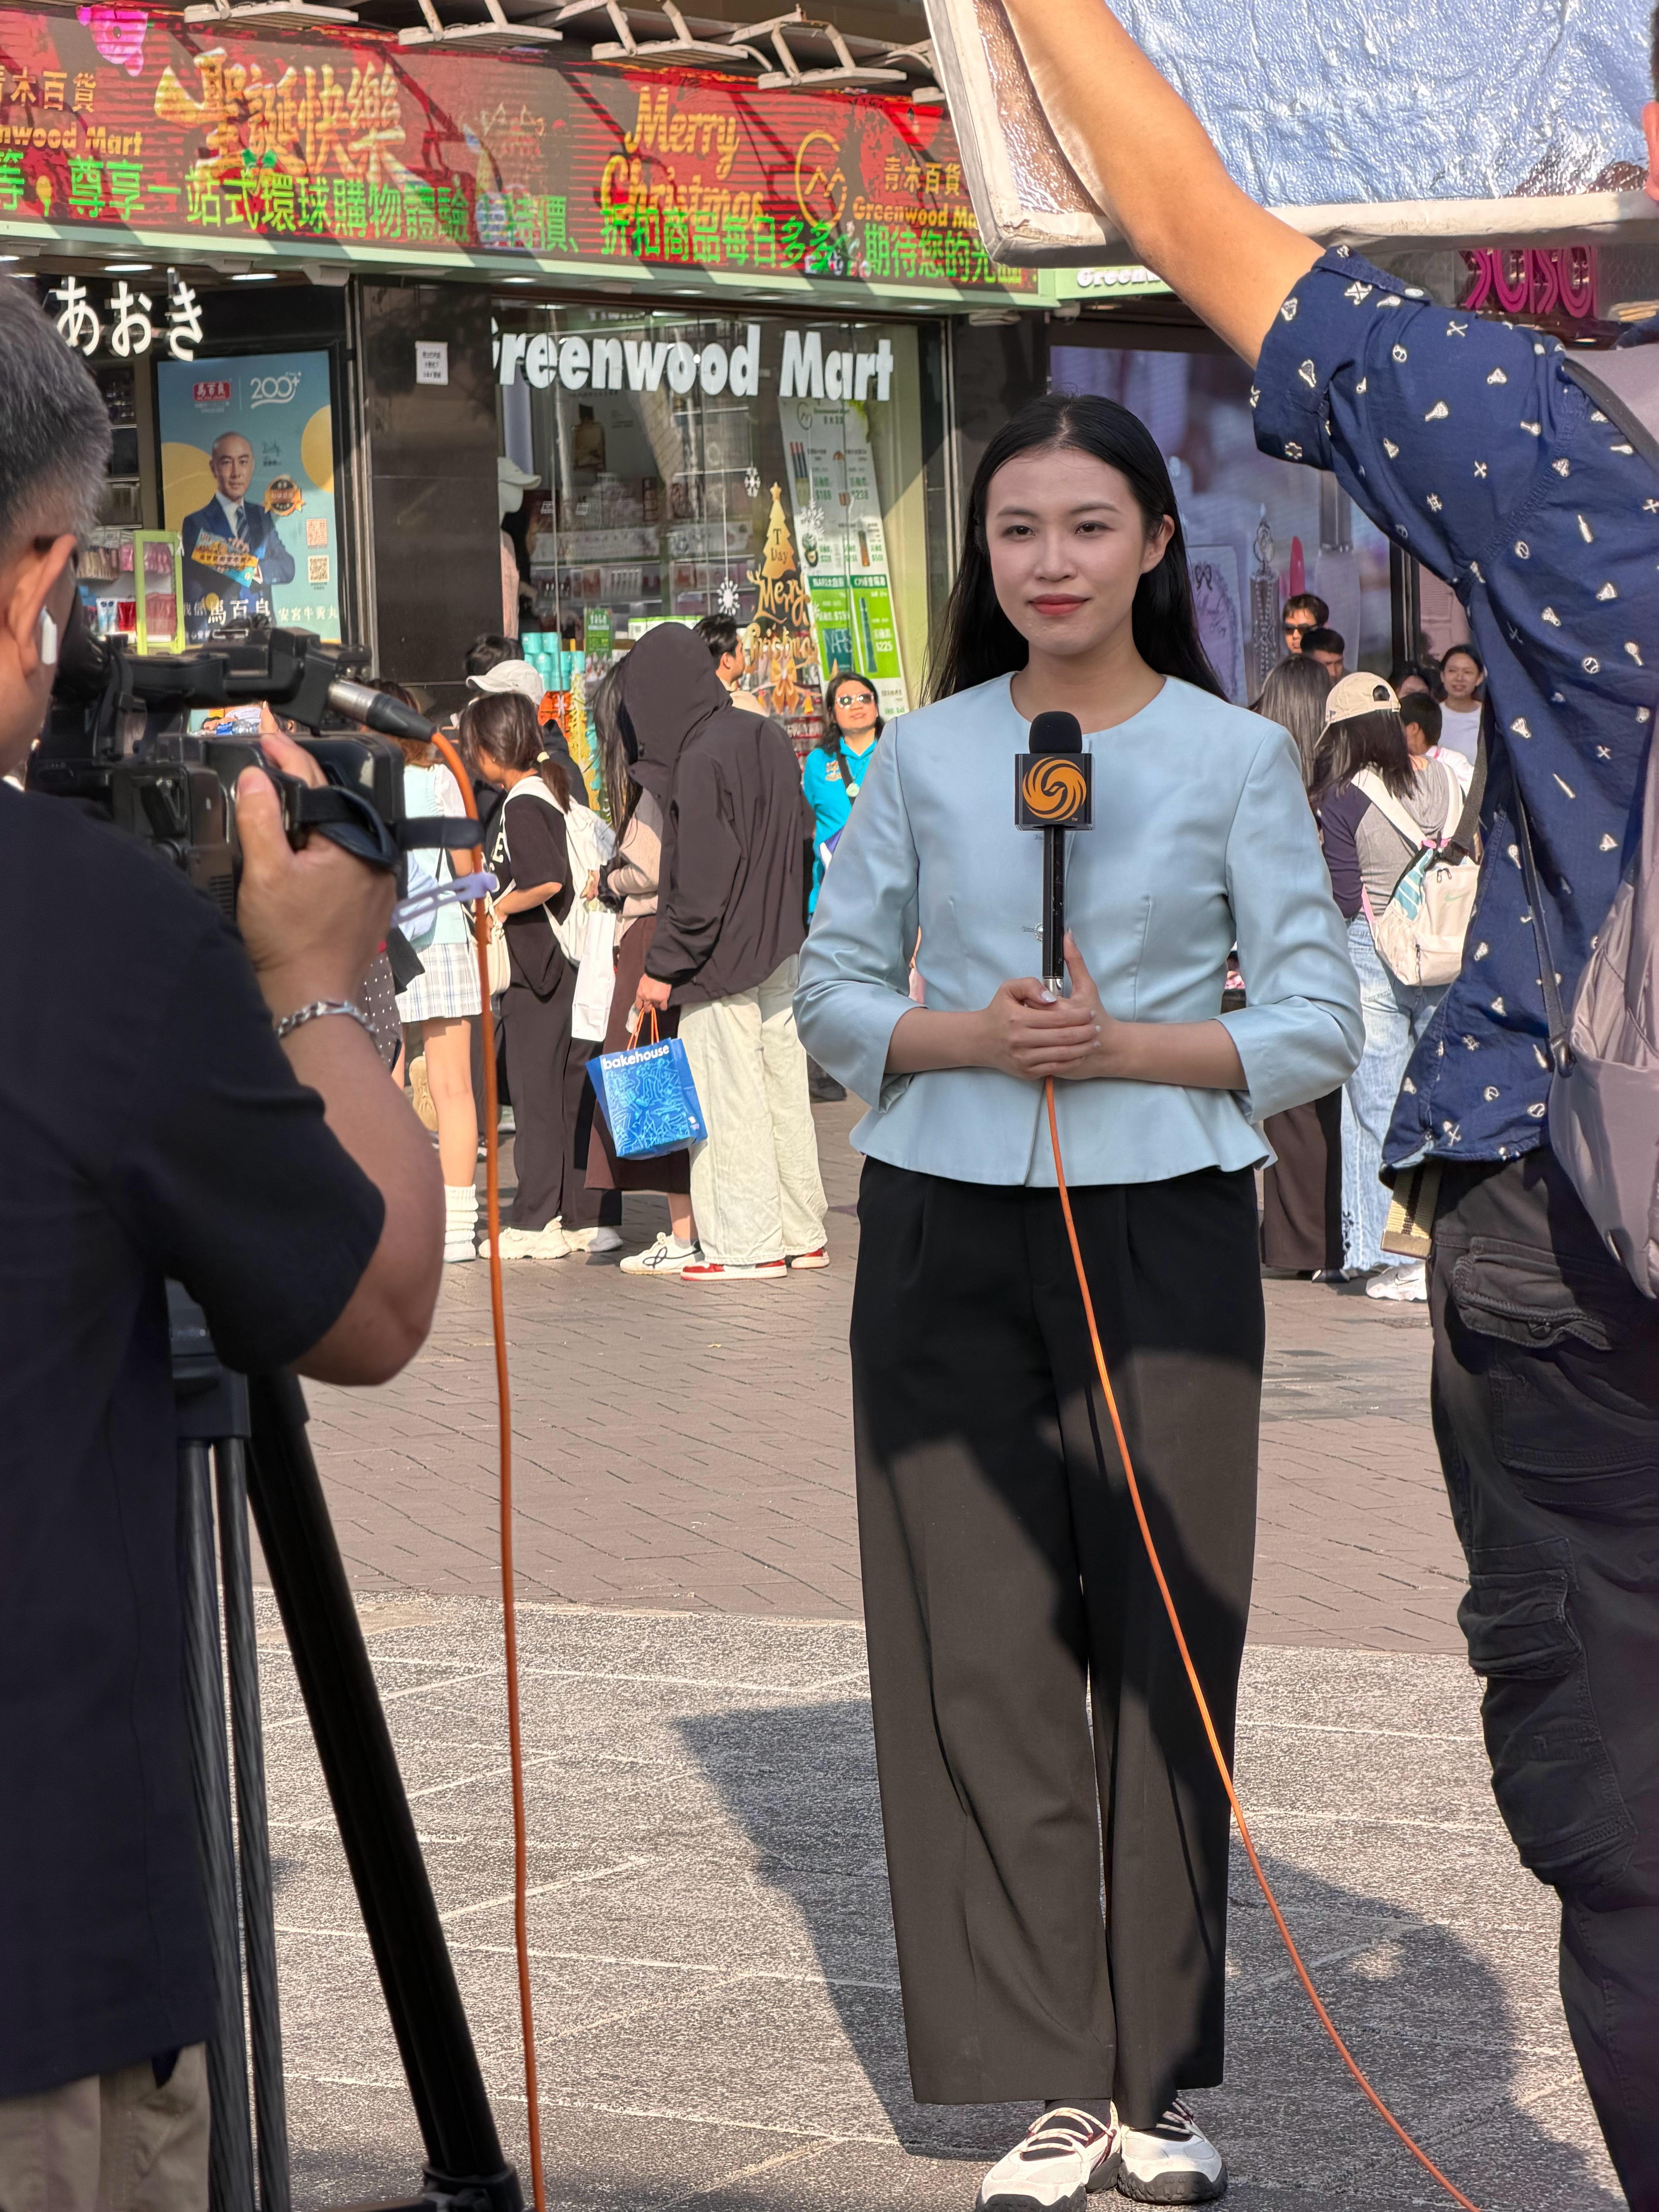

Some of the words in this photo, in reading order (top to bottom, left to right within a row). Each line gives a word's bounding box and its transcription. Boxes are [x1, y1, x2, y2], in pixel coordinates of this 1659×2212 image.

[0, 64, 96, 113] 木百貨
[85, 126, 143, 156] Mart
[624, 86, 740, 180] Merry
[601, 155, 765, 233] Christmas
[853, 196, 948, 226] Greenwood
[55, 275, 203, 362] あおき
[491, 316, 761, 397] reenwood
[779, 330, 893, 401] Mart
[771, 548, 788, 565] Day
[747, 573, 810, 627] Merry
[602, 1045, 669, 1071] bakehouse
